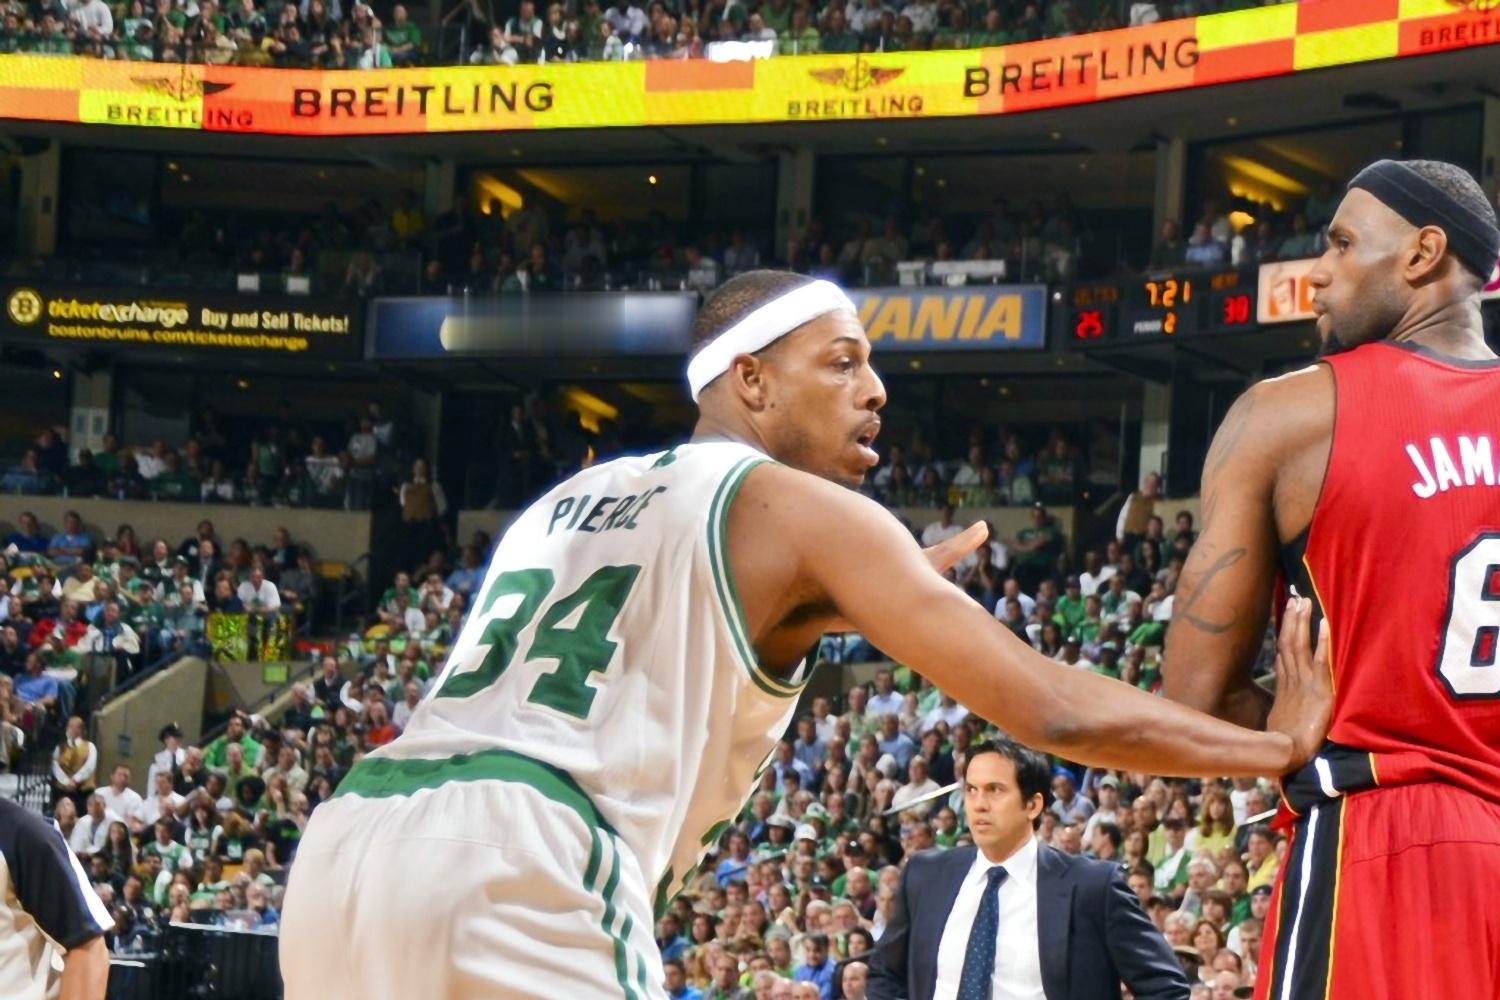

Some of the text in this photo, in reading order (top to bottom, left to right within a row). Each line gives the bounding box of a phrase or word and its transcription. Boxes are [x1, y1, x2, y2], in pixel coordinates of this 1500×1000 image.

[962, 37, 1201, 98] BREITLING
[106, 103, 254, 128] BREITLING
[291, 82, 555, 119] BREITLING
[787, 94, 924, 118] BREITLING
[201, 308, 228, 330] Buy
[231, 310, 259, 327] and
[262, 311, 289, 329] Sell
[433, 564, 642, 720] 34
